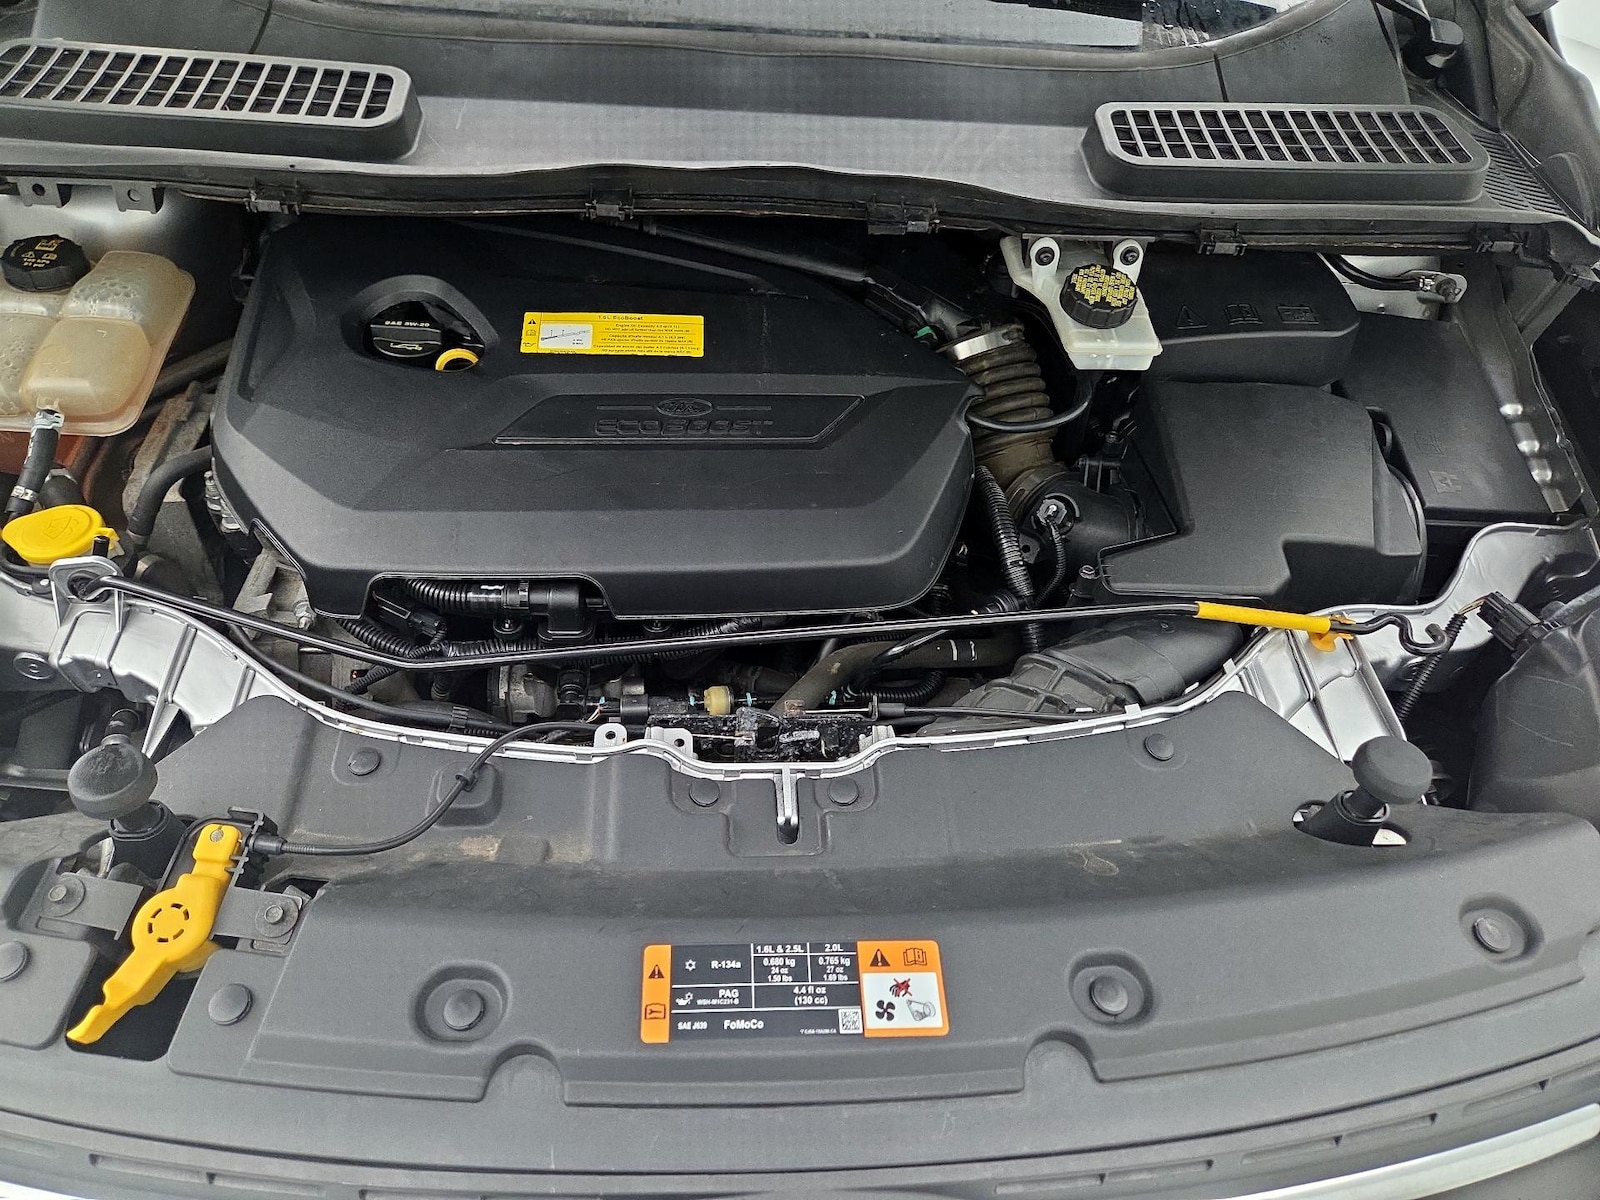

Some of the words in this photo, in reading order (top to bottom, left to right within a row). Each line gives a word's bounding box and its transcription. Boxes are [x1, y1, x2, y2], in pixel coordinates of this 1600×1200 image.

[756, 945, 775, 954] 1.6L
[776, 945, 785, 953] &
[785, 944, 805, 953] 2.5L
[824, 944, 844, 952] 2.0L
[711, 960, 742, 969] R-134a
[763, 957, 784, 966] 0.680
[785, 957, 796, 968] kg
[818, 956, 839, 965] 0.765
[840, 956, 851, 967] kg
[782, 974, 793, 982] lbs
[837, 973, 848, 981] lbs
[719, 989, 739, 998] PAG
[793, 986, 807, 994] 4.4
[807, 986, 815, 994] fl
[794, 996, 813, 1006] (130
[814, 996, 828, 1005] cc)
[723, 1019, 764, 1030] FoMoCo
